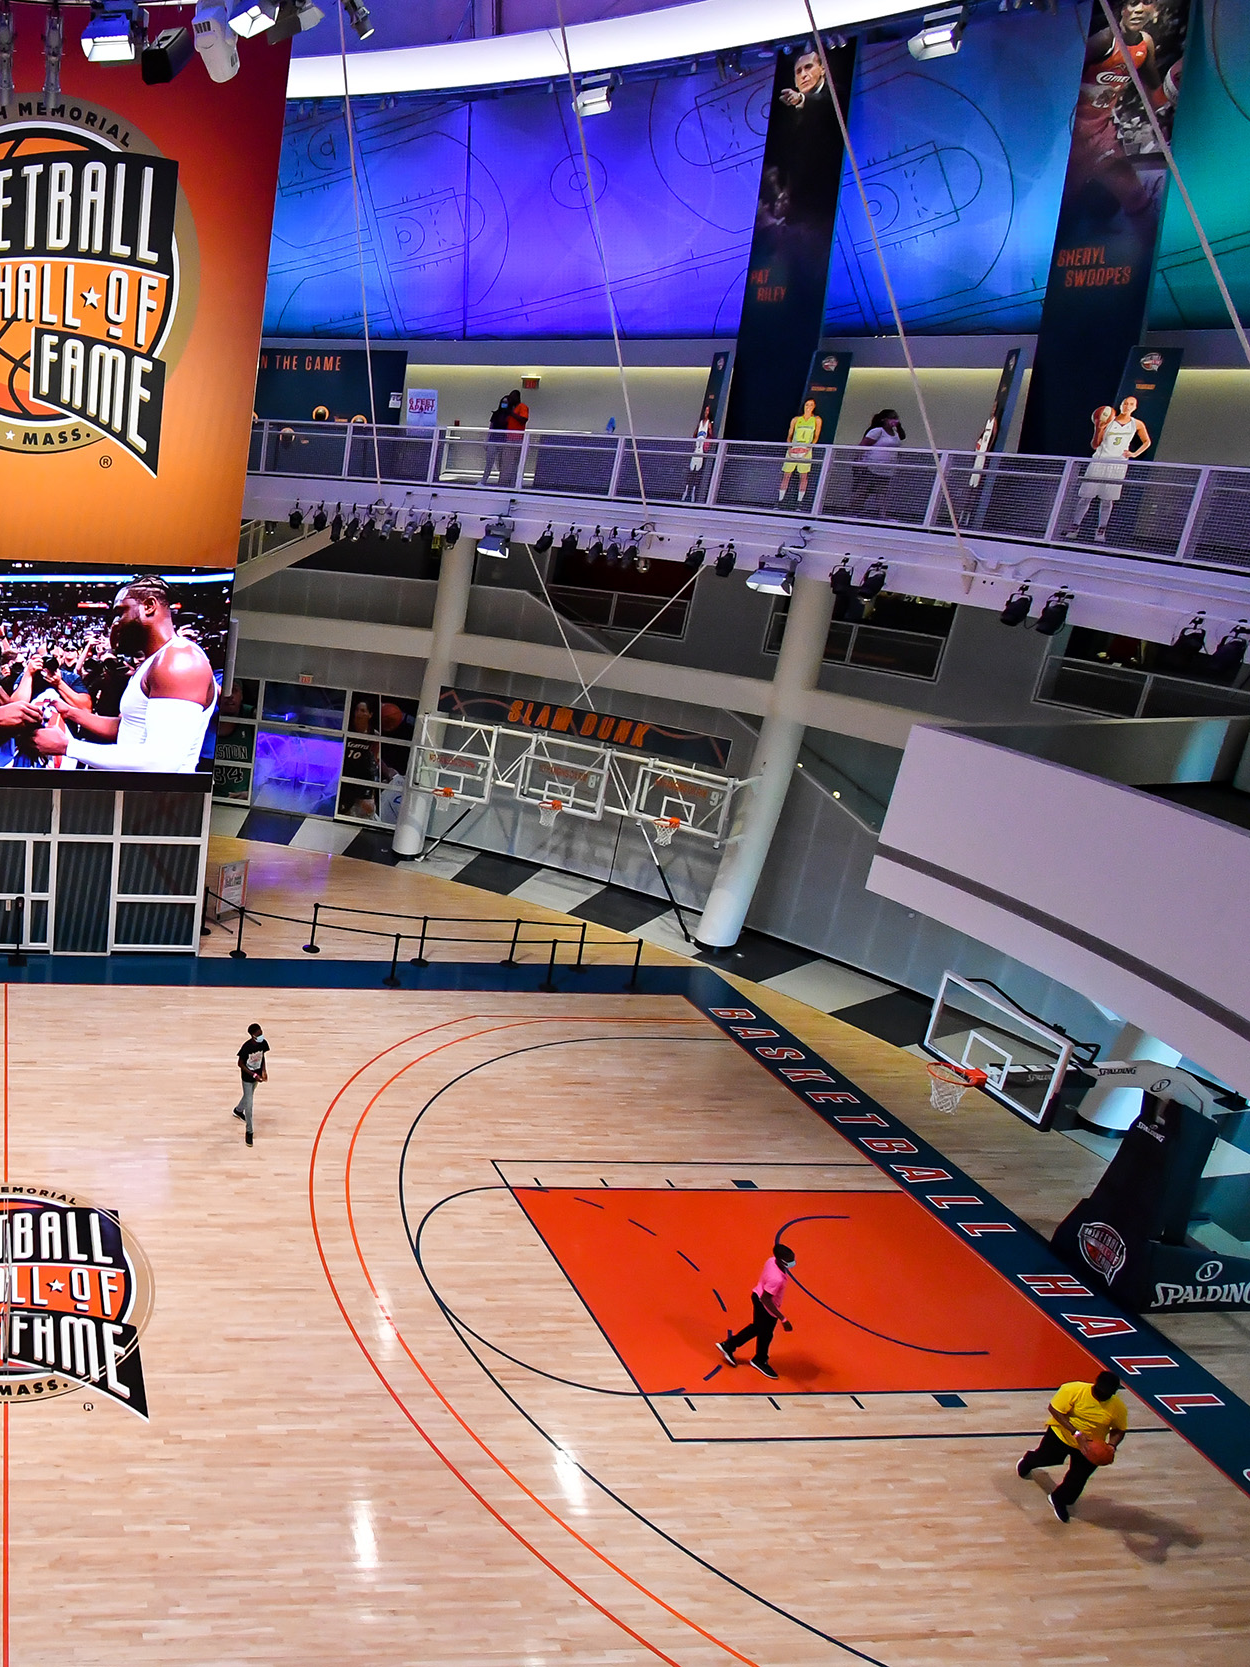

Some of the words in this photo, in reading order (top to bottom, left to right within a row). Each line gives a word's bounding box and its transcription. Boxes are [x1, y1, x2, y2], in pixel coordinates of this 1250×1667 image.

[18, 102, 131, 148] MEMORIAL
[1057, 247, 1106, 267] SHERYL
[751, 269, 770, 285] PAT
[1065, 266, 1132, 288] SWOOPES
[756, 286, 787, 302] RILEY
[106, 269, 159, 348] OF
[260, 355, 268, 369] N
[276, 355, 298, 370] THE
[305, 356, 341, 371] GAME
[40, 333, 153, 454] FAME
[22, 428, 92, 446] MASS.
[507, 700, 574, 733] SLAM
[579, 713, 651, 748] DUNK
[214, 744, 248, 760] STON
[347, 750, 362, 760] 10
[214, 767, 244, 786] 34
[1097, 1066, 1138, 1077] SPALDING
[708, 1007, 1017, 1238] BASKETBALL
[1136, 1121, 1166, 1143] SPALDING
[71, 1268, 118, 1316] OF
[10, 1311, 131, 1400] FAME
[1017, 1274, 1226, 1415] HALL
